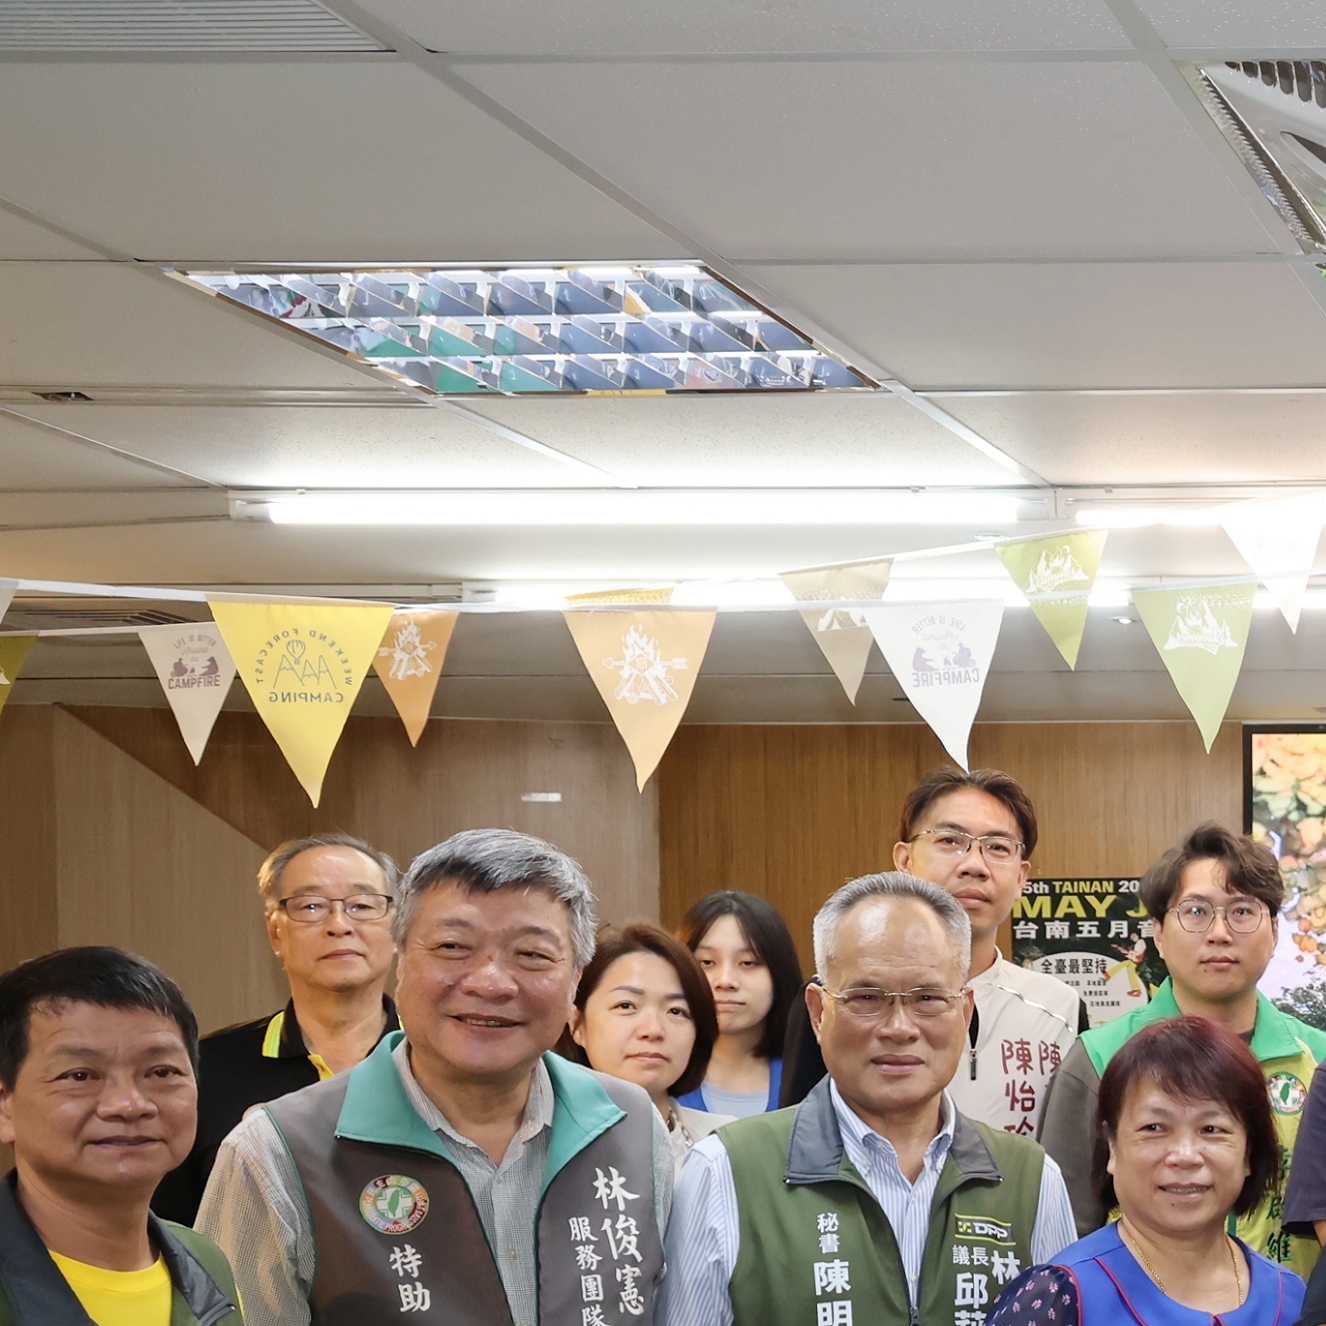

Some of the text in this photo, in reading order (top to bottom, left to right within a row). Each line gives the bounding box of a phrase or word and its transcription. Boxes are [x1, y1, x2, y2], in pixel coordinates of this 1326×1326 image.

[168, 674, 221, 690] CAMPFIRE
[1023, 880, 1049, 894] 5th
[1052, 880, 1114, 894] TAINAN
[1012, 894, 1118, 918] MAY
[1012, 919, 1155, 940] 台南五月音
[592, 1167, 646, 1317] 林俊憲
[816, 1211, 841, 1254] 秘書
[972, 1222, 1009, 1239] DPP
[952, 1244, 989, 1267] 議長
[388, 1244, 432, 1313] 特助
